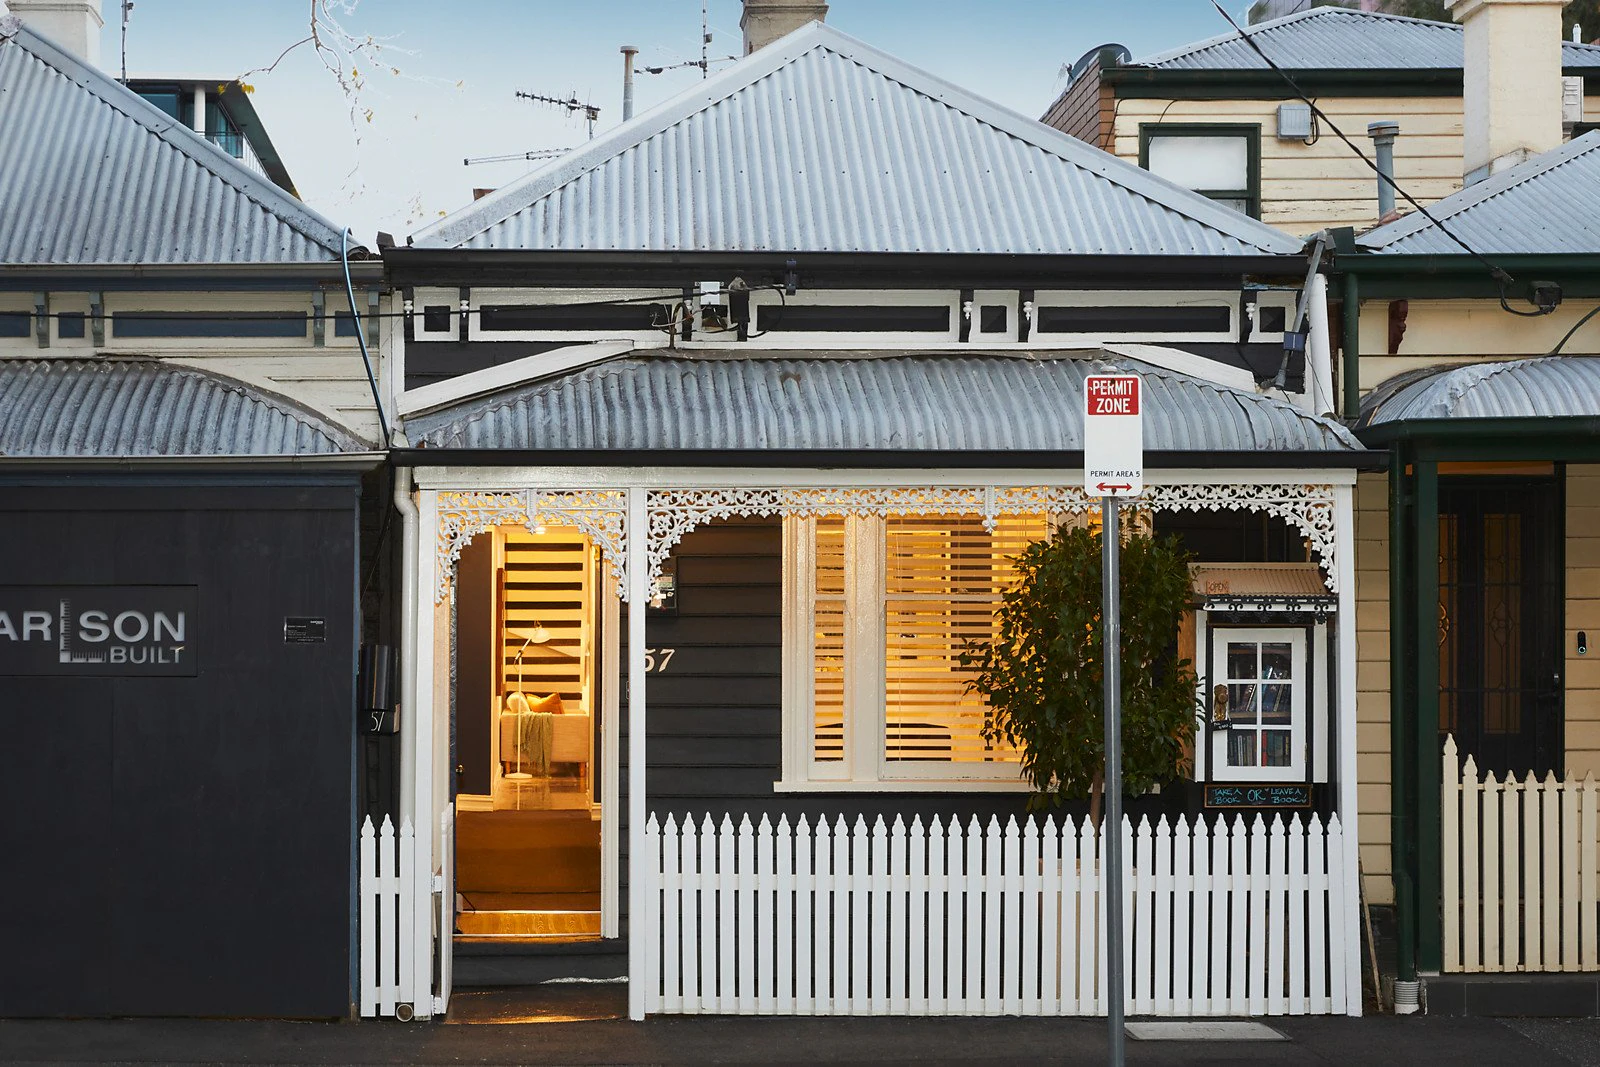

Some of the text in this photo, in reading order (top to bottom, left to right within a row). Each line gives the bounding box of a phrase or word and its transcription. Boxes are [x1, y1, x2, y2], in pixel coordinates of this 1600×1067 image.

[1092, 380, 1134, 395] PERMIT
[1096, 398, 1131, 413] ZONE
[1135, 470, 1141, 478] 5
[110, 645, 185, 664] BUILT
[1213, 788, 1233, 796] TAKE
[1215, 796, 1240, 805] BOOK
